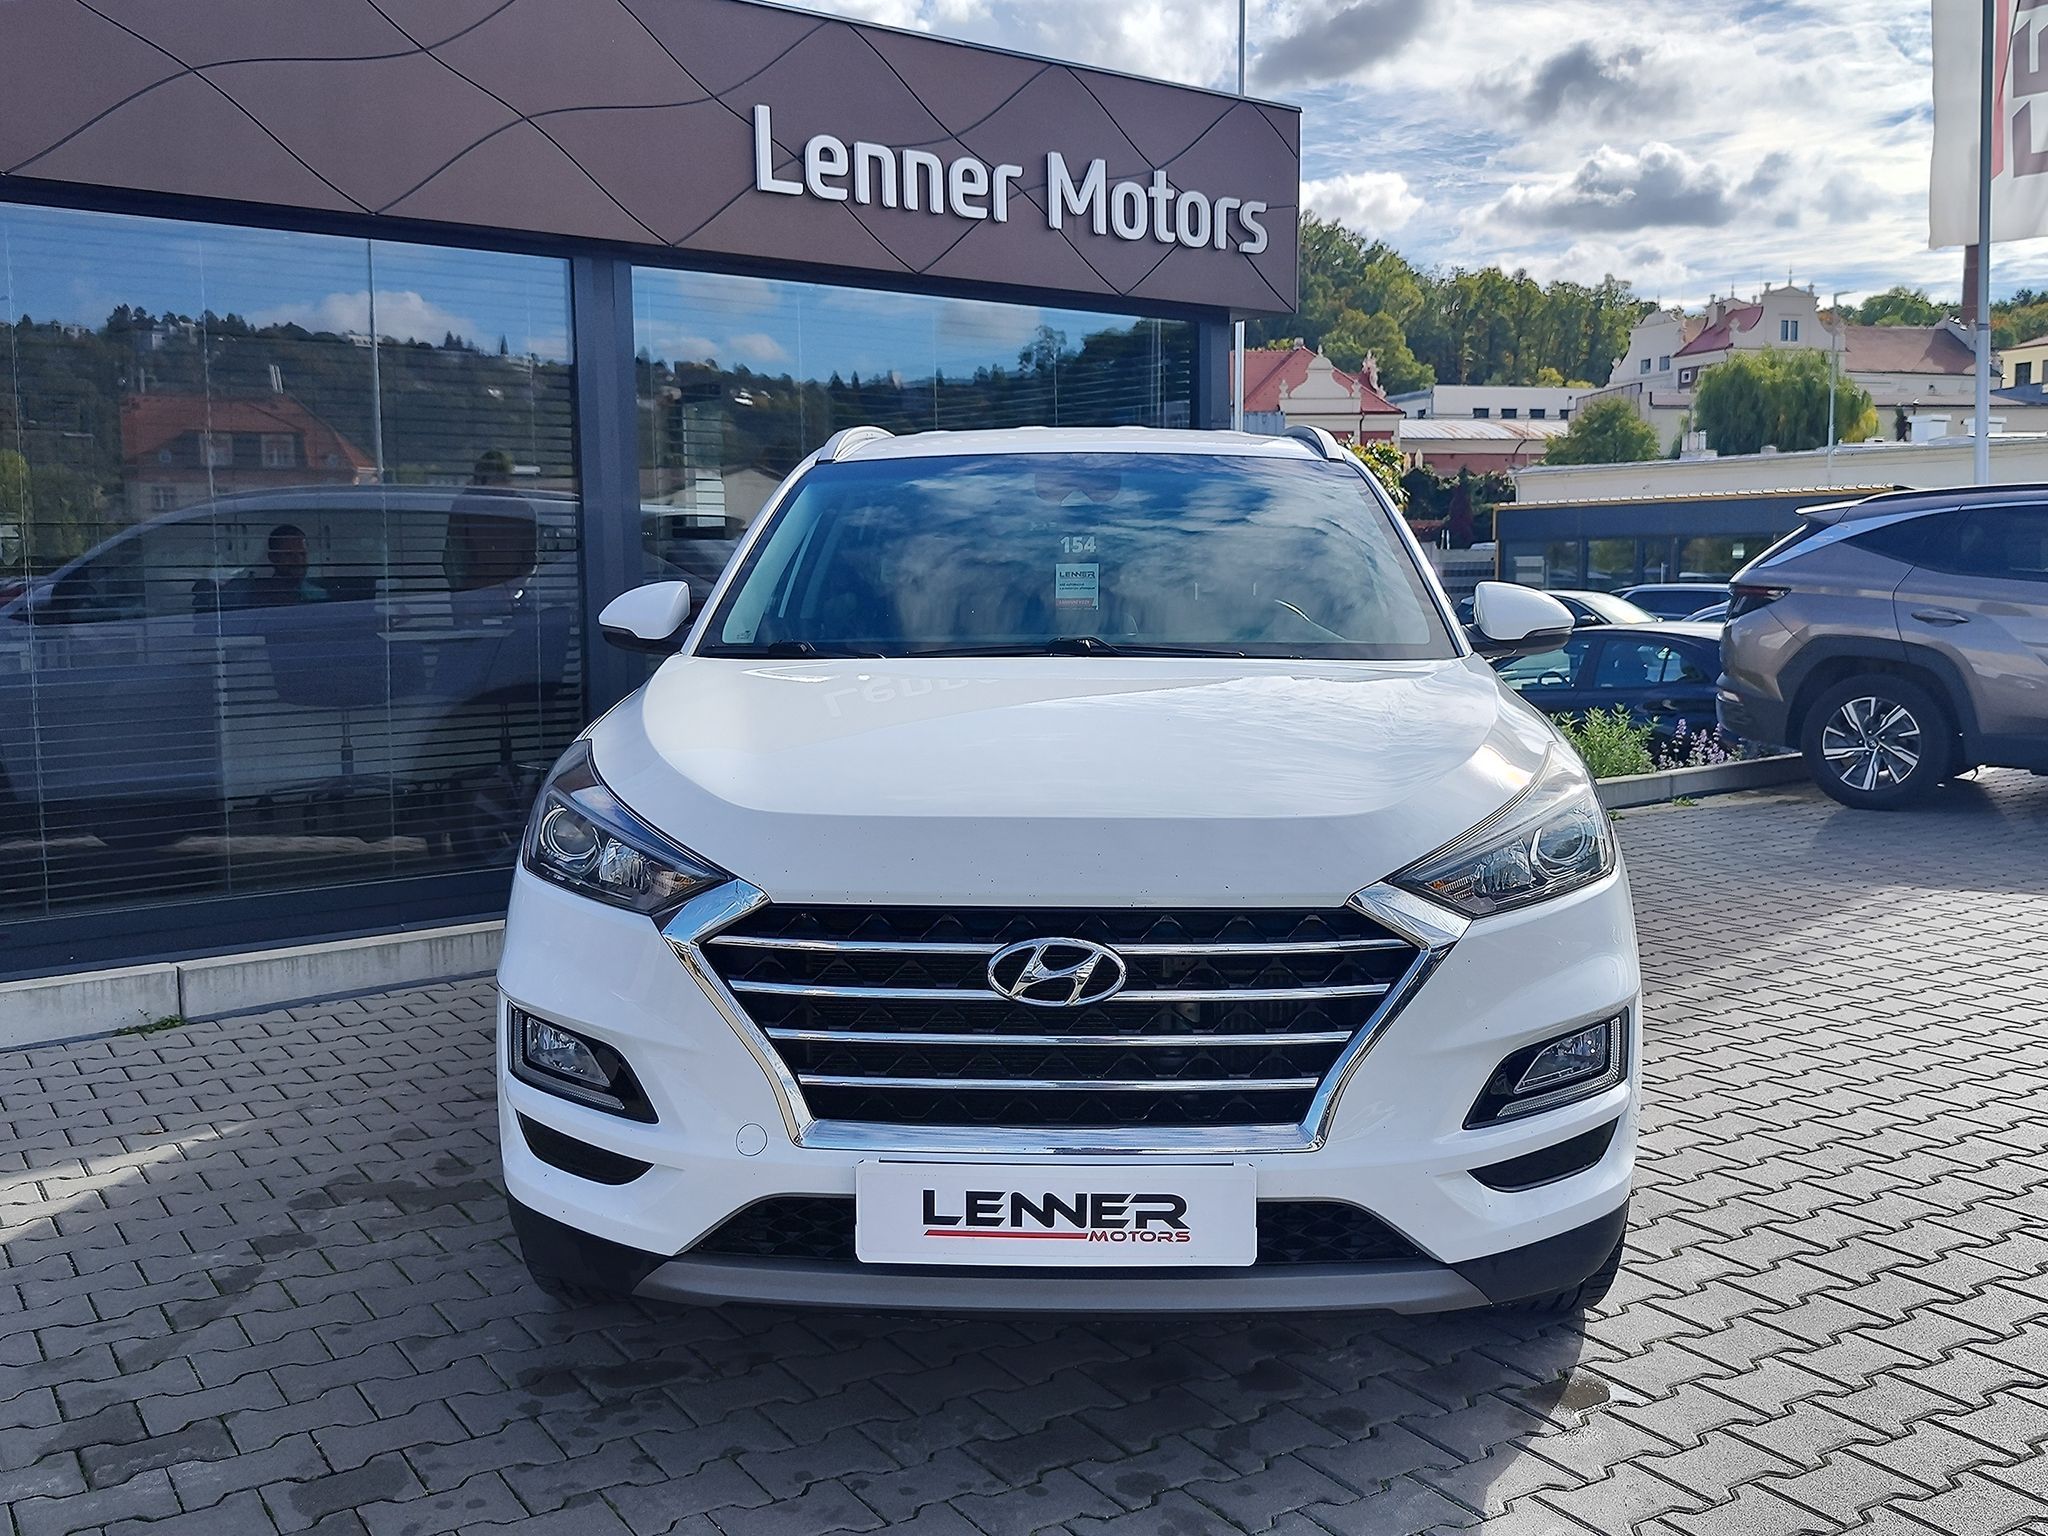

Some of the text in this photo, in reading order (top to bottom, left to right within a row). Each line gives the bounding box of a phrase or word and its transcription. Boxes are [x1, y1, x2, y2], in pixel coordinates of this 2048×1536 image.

[754, 104, 1269, 254] Lenner Motors
[1060, 536, 1097, 553] 154
[922, 1189, 1191, 1229] LENNER
[1088, 1230, 1191, 1243] MOTORS
